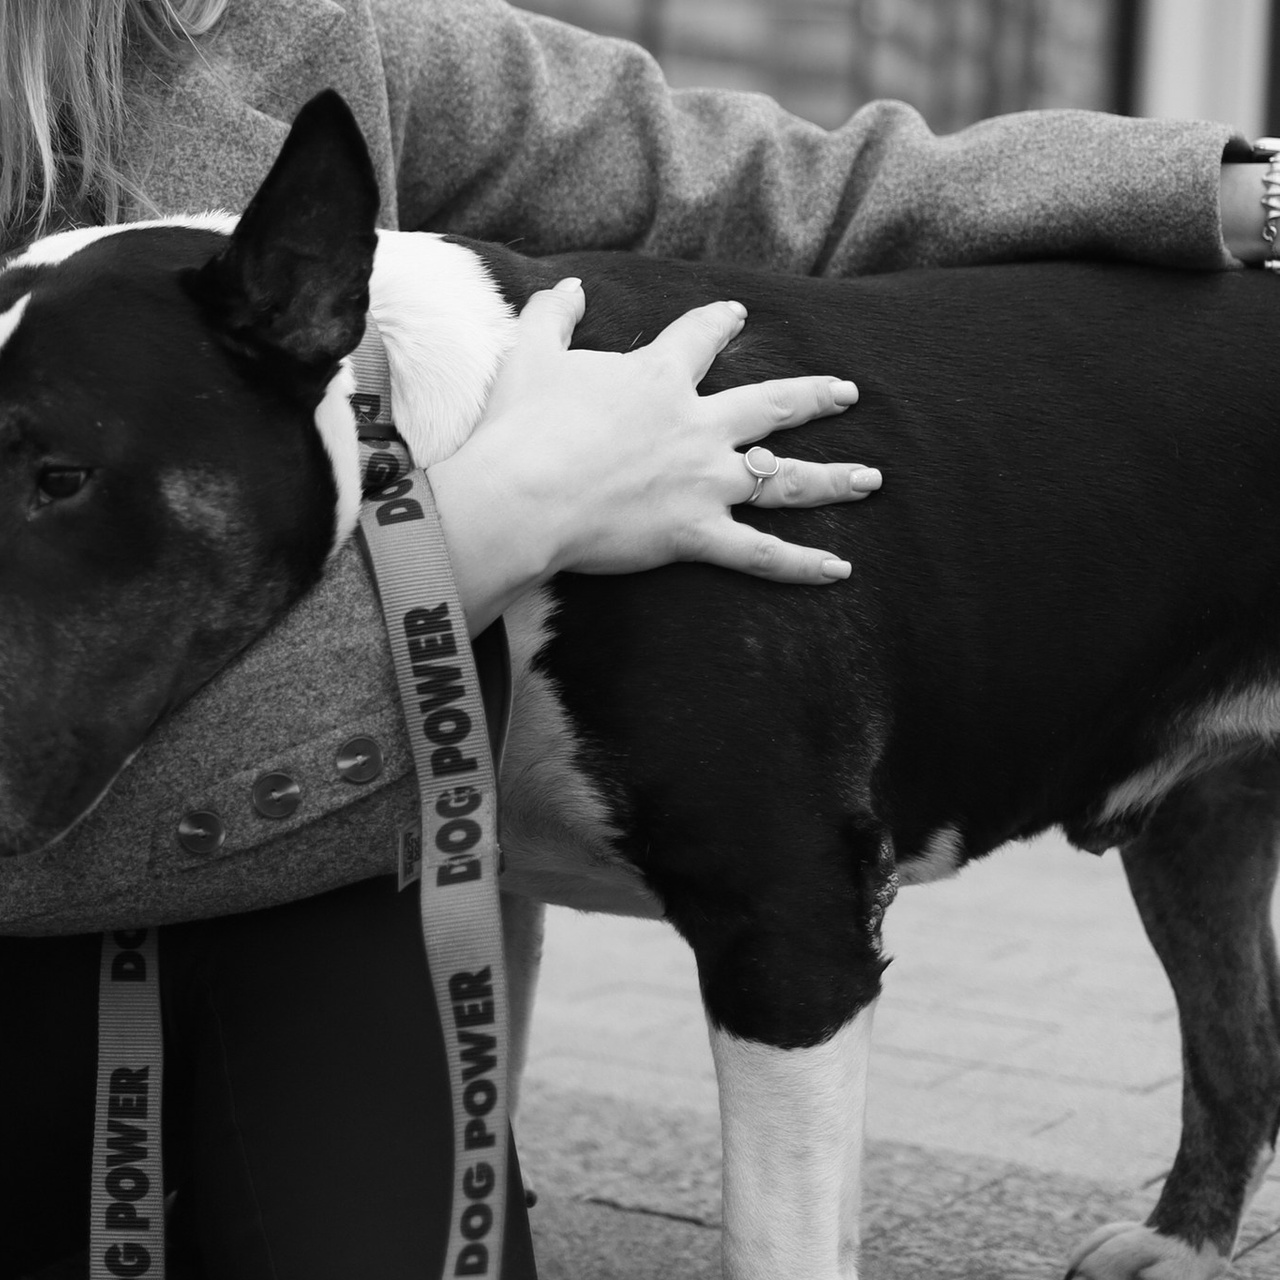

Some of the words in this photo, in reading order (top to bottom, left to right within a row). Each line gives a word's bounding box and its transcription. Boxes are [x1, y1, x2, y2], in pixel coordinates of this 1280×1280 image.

[404, 602, 478, 777] POWER
[435, 786, 482, 887] DOG
[448, 965, 498, 1151] POWER
[105, 1065, 150, 1231] POWER
[104, 1242, 151, 1280] G
[454, 1161, 496, 1277] DOG
